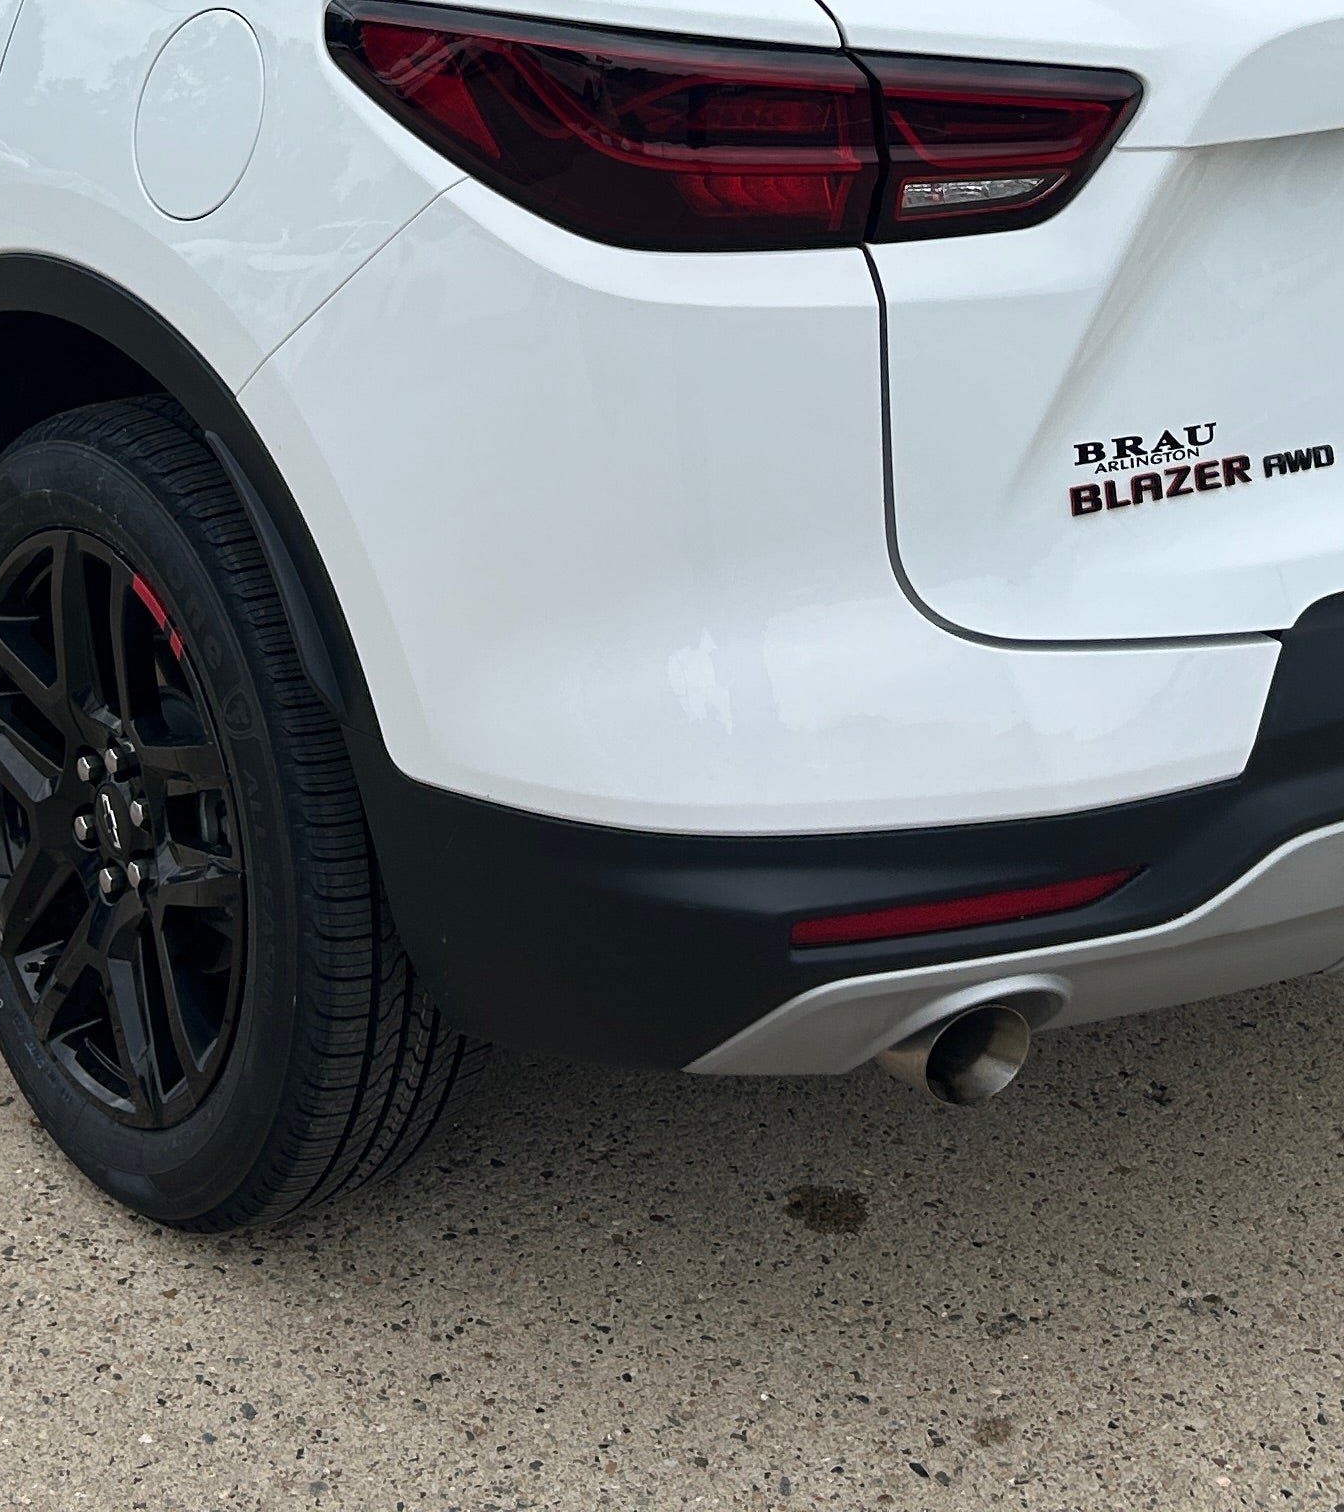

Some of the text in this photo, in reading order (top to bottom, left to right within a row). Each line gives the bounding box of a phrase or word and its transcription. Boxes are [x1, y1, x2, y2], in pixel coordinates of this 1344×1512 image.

[1073, 421, 1217, 466] BRAU
[1094, 446, 1200, 474] ARLINGTON
[1069, 443, 1335, 517] BLAZER AWD
